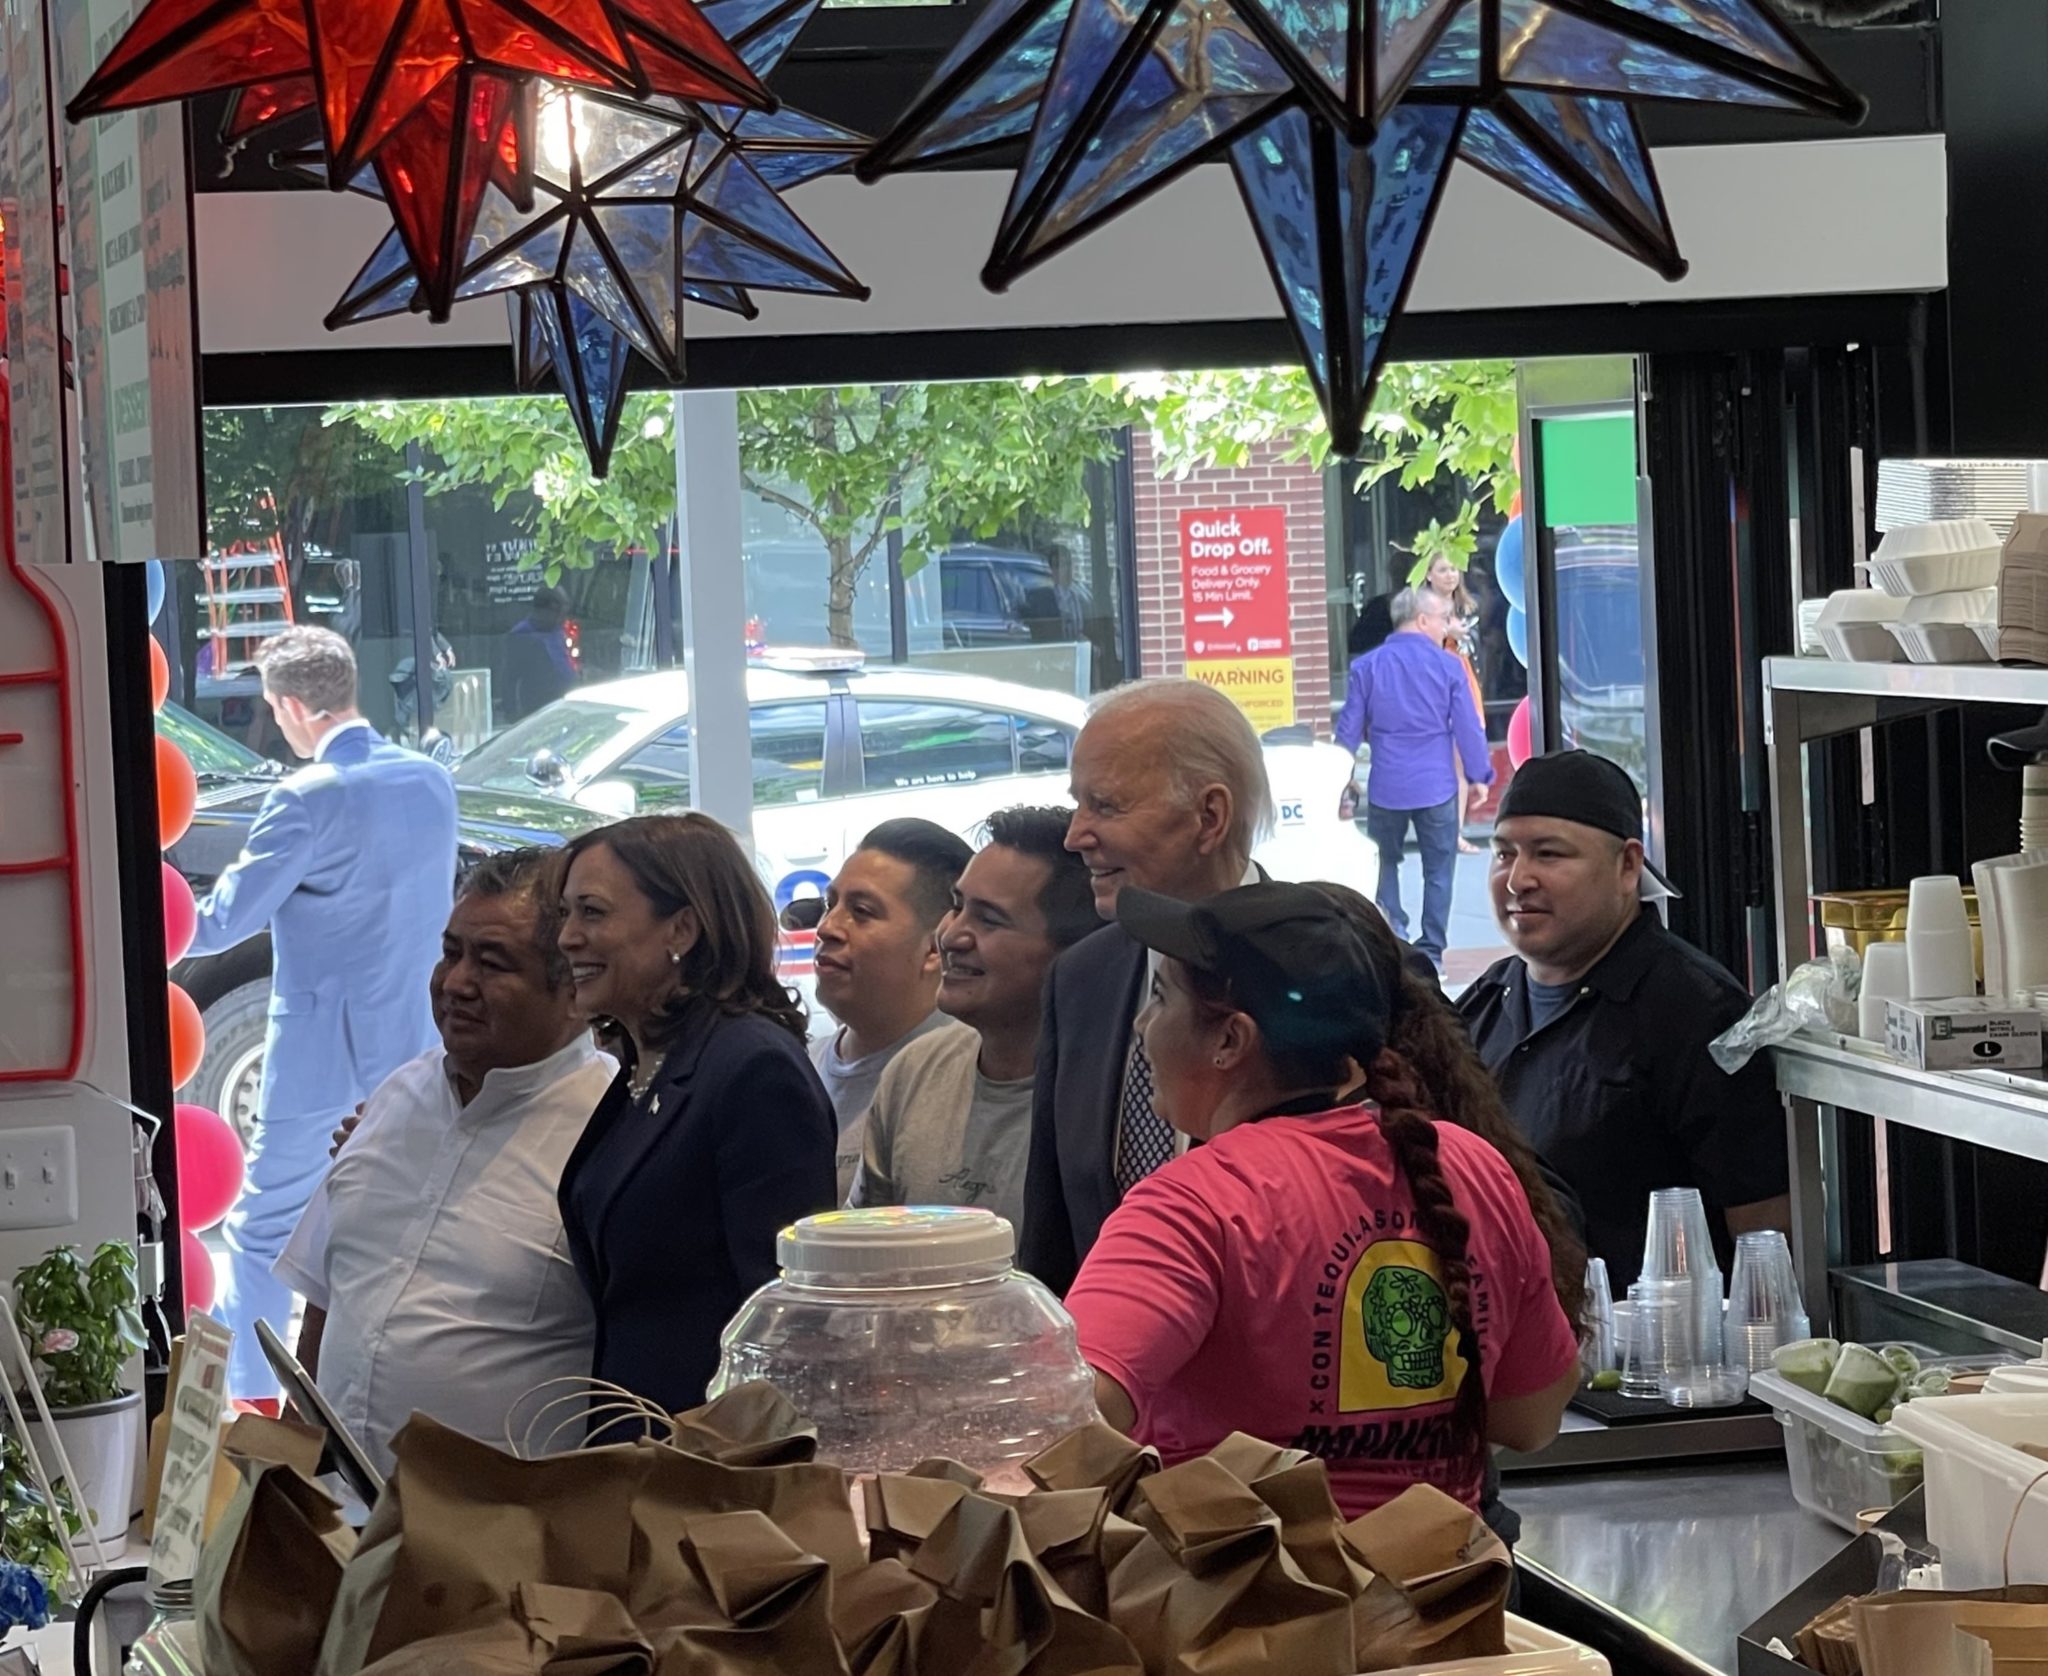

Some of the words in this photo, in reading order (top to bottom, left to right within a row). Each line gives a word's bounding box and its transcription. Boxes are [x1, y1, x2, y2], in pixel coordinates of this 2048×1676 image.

[1189, 513, 1241, 538] Quick
[1190, 540, 1235, 560] Drop
[1239, 537, 1273, 556] Off.
[1191, 565, 1219, 576] Food
[1220, 564, 1229, 576] &
[1230, 563, 1272, 576] Grocery
[1191, 578, 1234, 591] Delivery
[1192, 592, 1203, 603] 15
[1204, 591, 1224, 602] Min
[1195, 669, 1284, 685] WARNING
[894, 777, 909, 787] We
[911, 776, 925, 786] are
[926, 774, 946, 784] here
[946, 772, 957, 781] to
[957, 770, 977, 781] help
[1281, 804, 1303, 820] DC
[1984, 1043, 1991, 1054] L
[1311, 1330, 1333, 1391] CON
